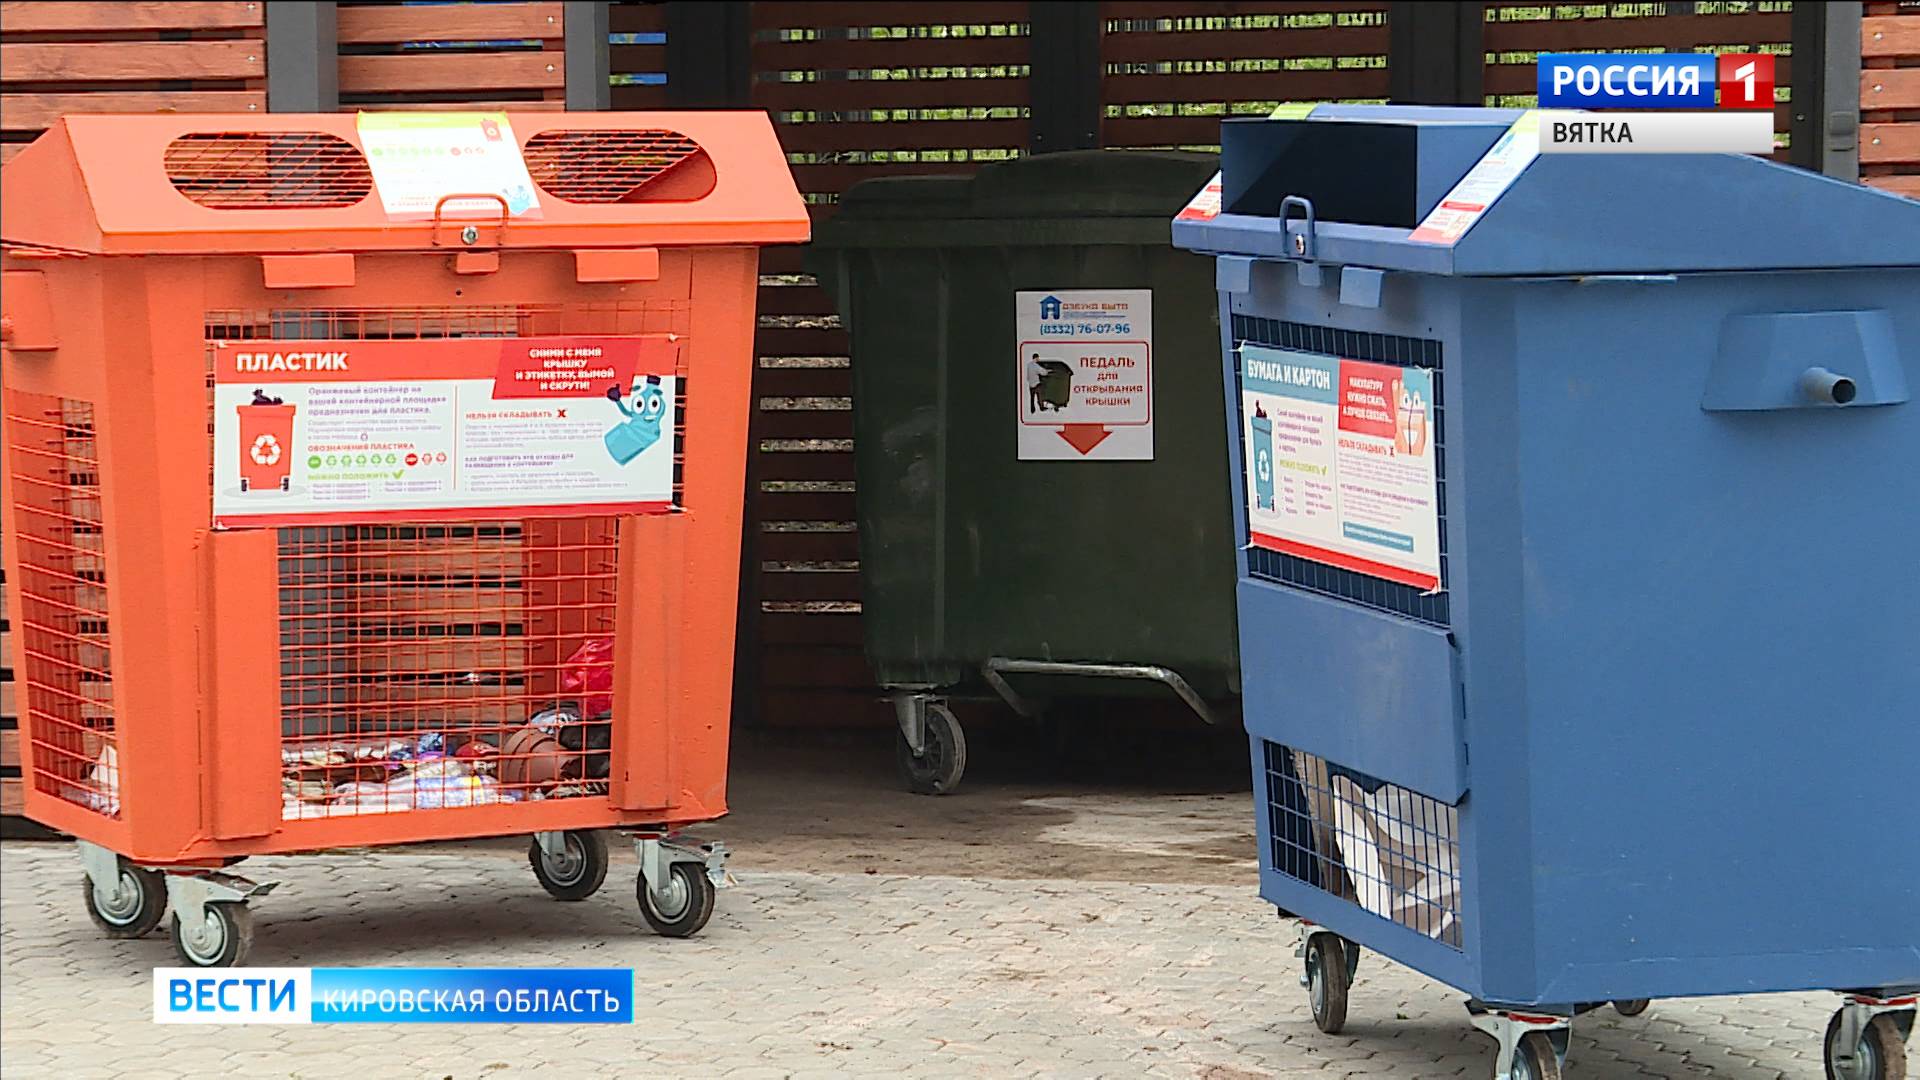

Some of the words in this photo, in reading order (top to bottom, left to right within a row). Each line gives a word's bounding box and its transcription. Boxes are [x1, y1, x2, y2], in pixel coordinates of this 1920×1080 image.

[1040, 324, 1074, 335] (8332)
[1078, 323, 1130, 334] 76-07-96
[529, 348, 564, 358] СНИМИ
[566, 349, 574, 357] С
[575, 347, 602, 357] МЕНЯ
[236, 352, 348, 372] ПЛАСТИК
[543, 359, 588, 368] КРЫШКУ
[1080, 357, 1135, 369] ПЕДАЛЬ
[515, 371, 523, 380] И
[525, 370, 576, 380] ЭТИКЕТКУ,
[578, 367, 615, 379] ВЫМОЙ
[1247, 359, 1283, 382] БУМАГА
[1284, 365, 1291, 384] И
[1292, 367, 1331, 390] КАРТОН
[540, 381, 548, 390] И
[1073, 385, 1143, 394] ОТКРЫВАНИЯ
[1085, 397, 1131, 406] КРЫШКИ
[466, 412, 496, 420] НЕЛЬЗЯ
[498, 411, 552, 419] СКЛАДЫВАТЬ
